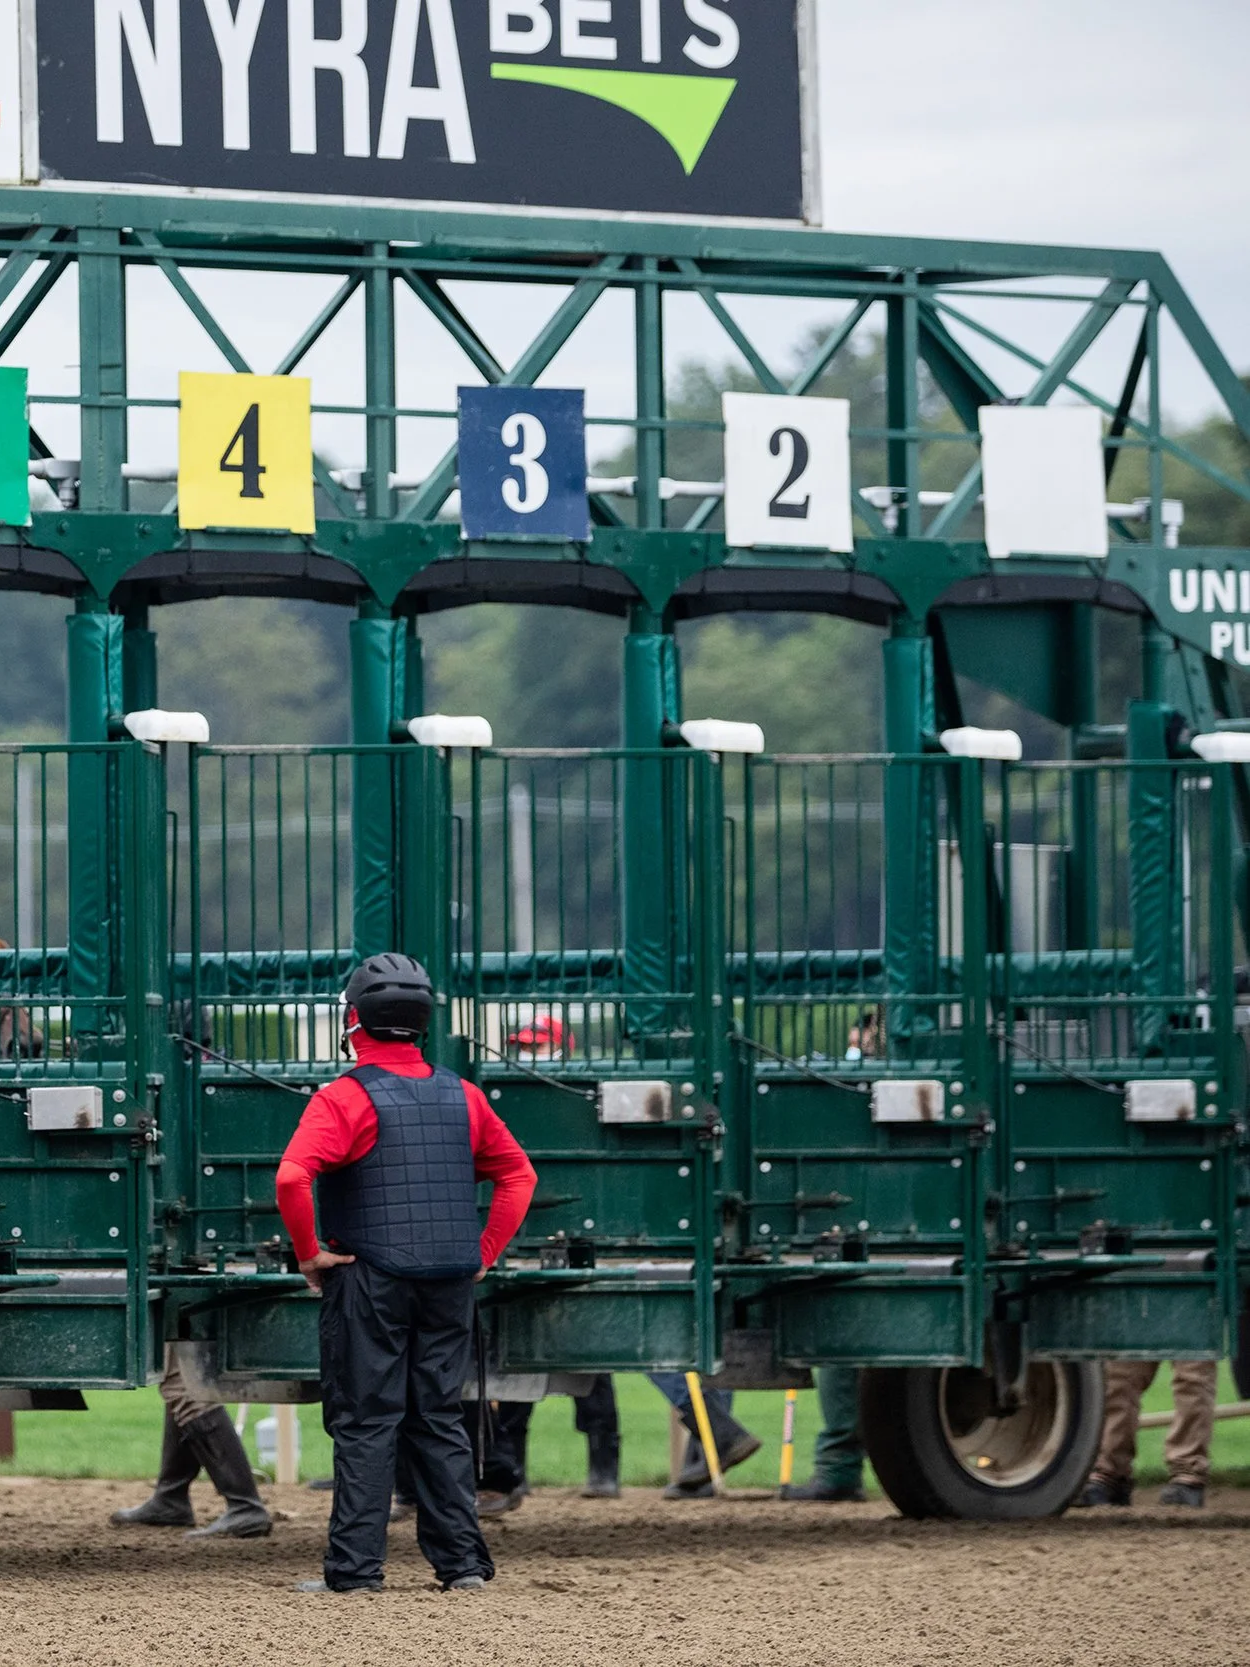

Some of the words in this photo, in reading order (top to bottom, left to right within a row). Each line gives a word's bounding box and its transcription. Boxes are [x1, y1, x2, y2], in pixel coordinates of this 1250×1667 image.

[489, 0, 740, 69] BETS
[94, 0, 477, 165] NYRA
[220, 403, 266, 499] 4
[501, 413, 548, 513] 3
[769, 427, 810, 519] 2
[1168, 568, 1250, 614] UNI
